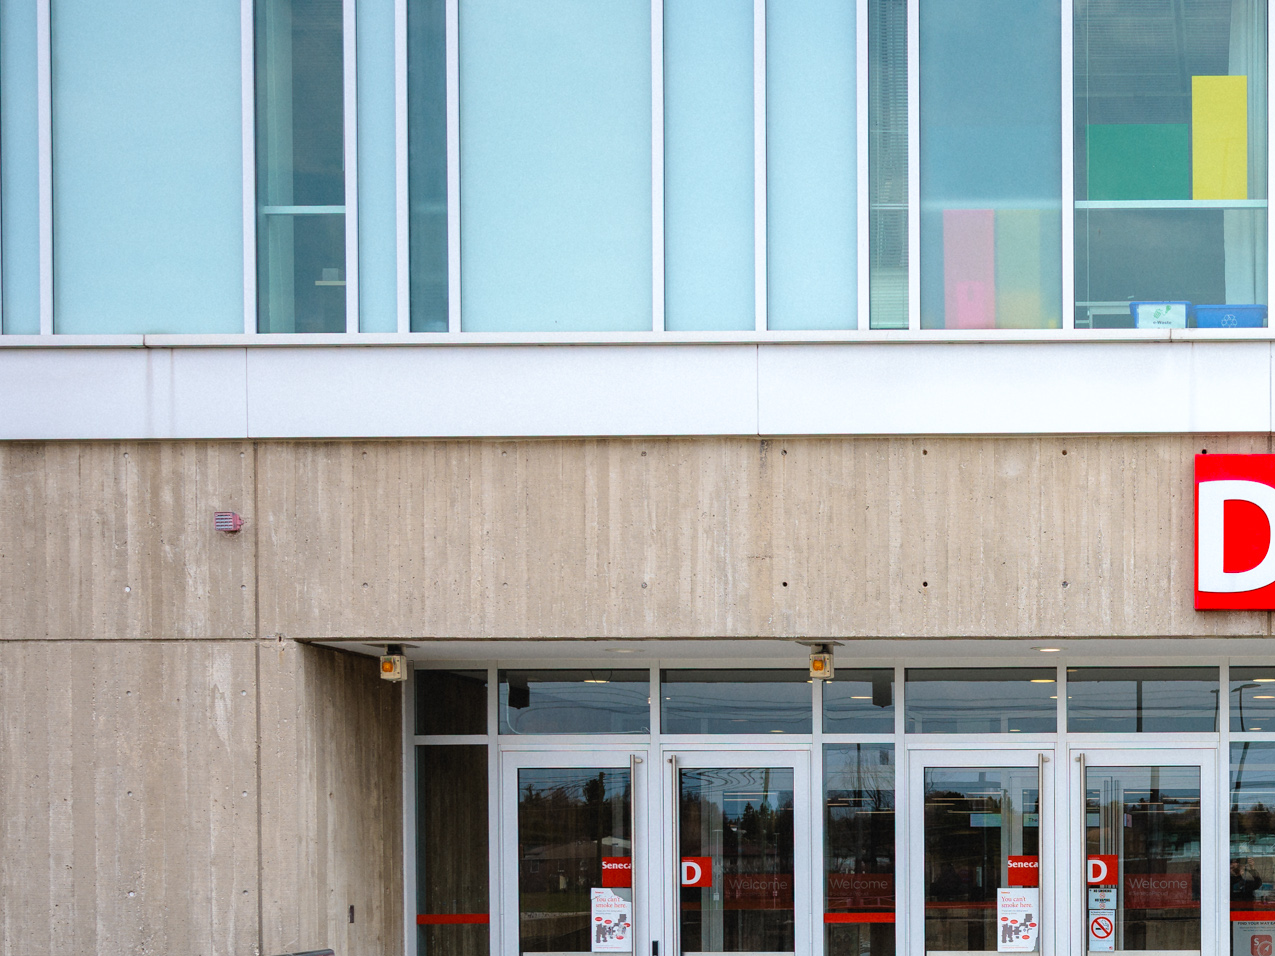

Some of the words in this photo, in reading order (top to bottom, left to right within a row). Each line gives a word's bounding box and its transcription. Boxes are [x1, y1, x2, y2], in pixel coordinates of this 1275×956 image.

[602, 861, 632, 870] Seneca
[1007, 859, 1039, 868] Seneca
[681, 861, 702, 885] D
[1087, 859, 1108, 883] D
[729, 878, 788, 890] Welcome
[830, 878, 888, 890] Welcome
[1129, 877, 1188, 889] Welcome
